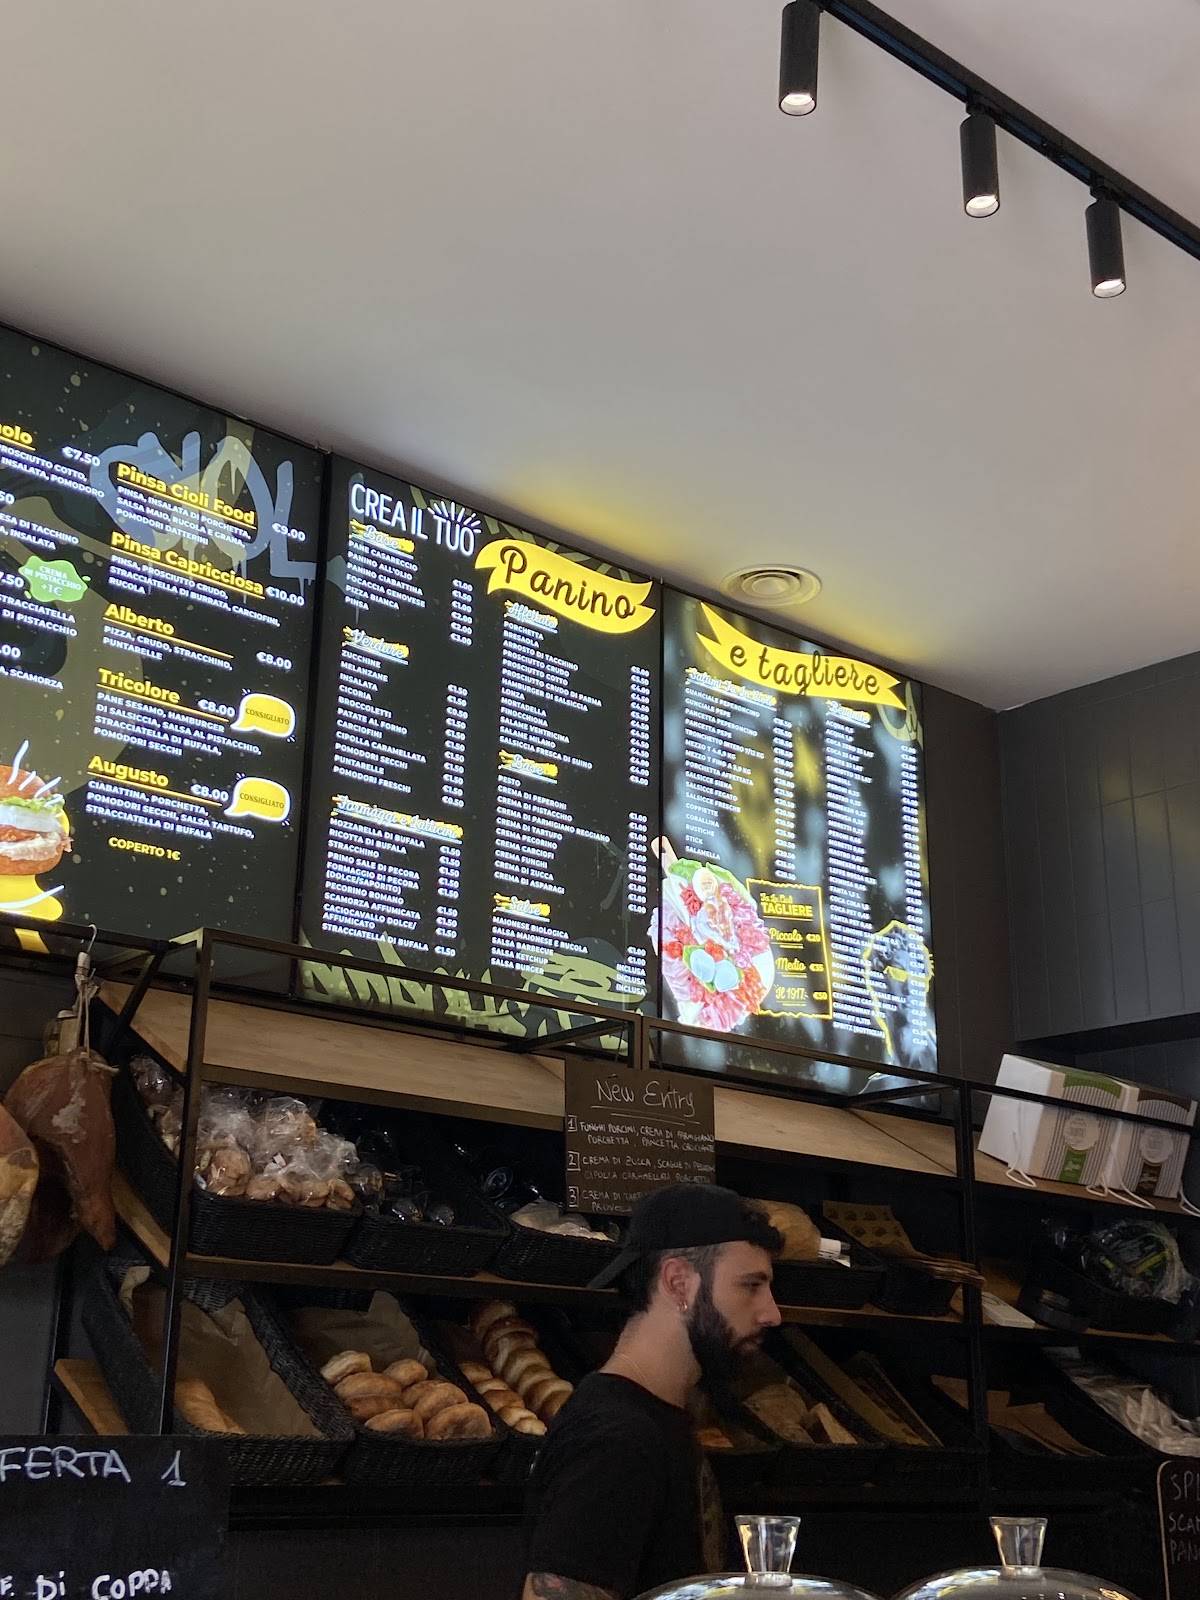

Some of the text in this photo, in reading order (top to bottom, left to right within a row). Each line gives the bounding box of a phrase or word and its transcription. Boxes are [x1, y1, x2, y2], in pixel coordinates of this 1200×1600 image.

[0, 424, 33, 445] olo
[0, 444, 87, 482] ROSCIUTTO COTTO,
[62, 446, 100, 466] €7.50
[1, 457, 104, 498] INSALATA, POMODORO
[117, 462, 255, 525] Pinsa Cioli Food
[117, 497, 144, 513] SALSA
[172, 513, 206, 534] RUCOLA
[207, 525, 214, 536] E
[118, 486, 251, 540] PINSA, INSALATA DI PORCHETTA,
[351, 483, 475, 557] CREA IL TUO
[10, 529, 56, 550] INSALATA
[19, 520, 30, 530] DI
[31, 522, 79, 544] TACCHINO
[272, 522, 306, 541] €9.00
[111, 531, 264, 595] Pinsa Capricciosa
[348, 551, 378, 568] PANINO
[109, 576, 146, 595] RUCOLA
[111, 555, 229, 600] PINSA, PROSCIUTTO CRUDO,
[500, 545, 636, 619] Panino
[265, 586, 305, 606] €10.00
[344, 596, 370, 611] PINSA
[346, 573, 426, 609] FOCACCIA GENOVESE
[0, 594, 76, 623] TRACCIATELLA
[105, 603, 175, 635] Alberto
[2, 609, 77, 637] DI PISTACCHIO
[503, 620, 544, 641] PORCHETTA
[103, 636, 163, 661] PUNTARELLE
[104, 625, 233, 671] PIZZA, CRUDO, STRACCHINO,
[503, 630, 540, 648] BRESAOLA
[256, 651, 292, 670] €8.00
[340, 661, 389, 682] MELANZANE
[341, 649, 381, 669] ZUCCHINE
[502, 649, 570, 678] PROSCIUTTO CRUDO
[730, 645, 747, 667] e
[759, 647, 879, 696] tagliere
[10, 668, 64, 690] SCAMORZA
[339, 672, 379, 692] INSALATA
[98, 668, 236, 718] Tricolore €8.00
[339, 684, 373, 701] CICORIA
[501, 687, 526, 701] LONZA
[97, 692, 225, 733] PANE SESAMO, HAMBURGER
[245, 708, 290, 726] CONSIGLIATO
[338, 696, 392, 719] BROCCOLETTI
[501, 697, 547, 717] MORTADELLA
[501, 706, 549, 727] FINOCCHIONA
[95, 715, 222, 757] STRACCIATELLA DI BUFALA,
[96, 703, 262, 756] DI SALSICCIA, SALSA AL PISTACCHIO,
[336, 719, 383, 739] CARCIOFINI
[335, 742, 408, 770] POMODORI SECCHI
[88, 756, 229, 802] Augusto €8.00
[498, 774, 521, 787] PESTO
[88, 780, 209, 816] CIABATTINA, PORCHETTA,
[239, 792, 285, 809] CONSIGLIATO
[85, 804, 213, 840] STRACCIATELLA DI BUFALA
[87, 792, 255, 839] POMODORI SECCHI, SALSA TARTUFO,
[330, 817, 425, 848] MOZZARELLA DI BUFALA
[108, 836, 181, 861] COPERTO 1€
[328, 840, 380, 858] STRACCHINO
[325, 880, 404, 905] PECORINO ROMANO
[324, 892, 421, 920] SCAMORZA AFFUMICATA
[762, 902, 813, 917] TAGLIERE
[492, 916, 569, 940] MAIONESE BIOLOGICA
[769, 927, 803, 942] Piccolo
[491, 947, 514, 958] SALSA
[775, 957, 806, 972] Medio
[596, 1079, 695, 1118] New Entry
[0, 1446, 188, 1487] FERTA 1
